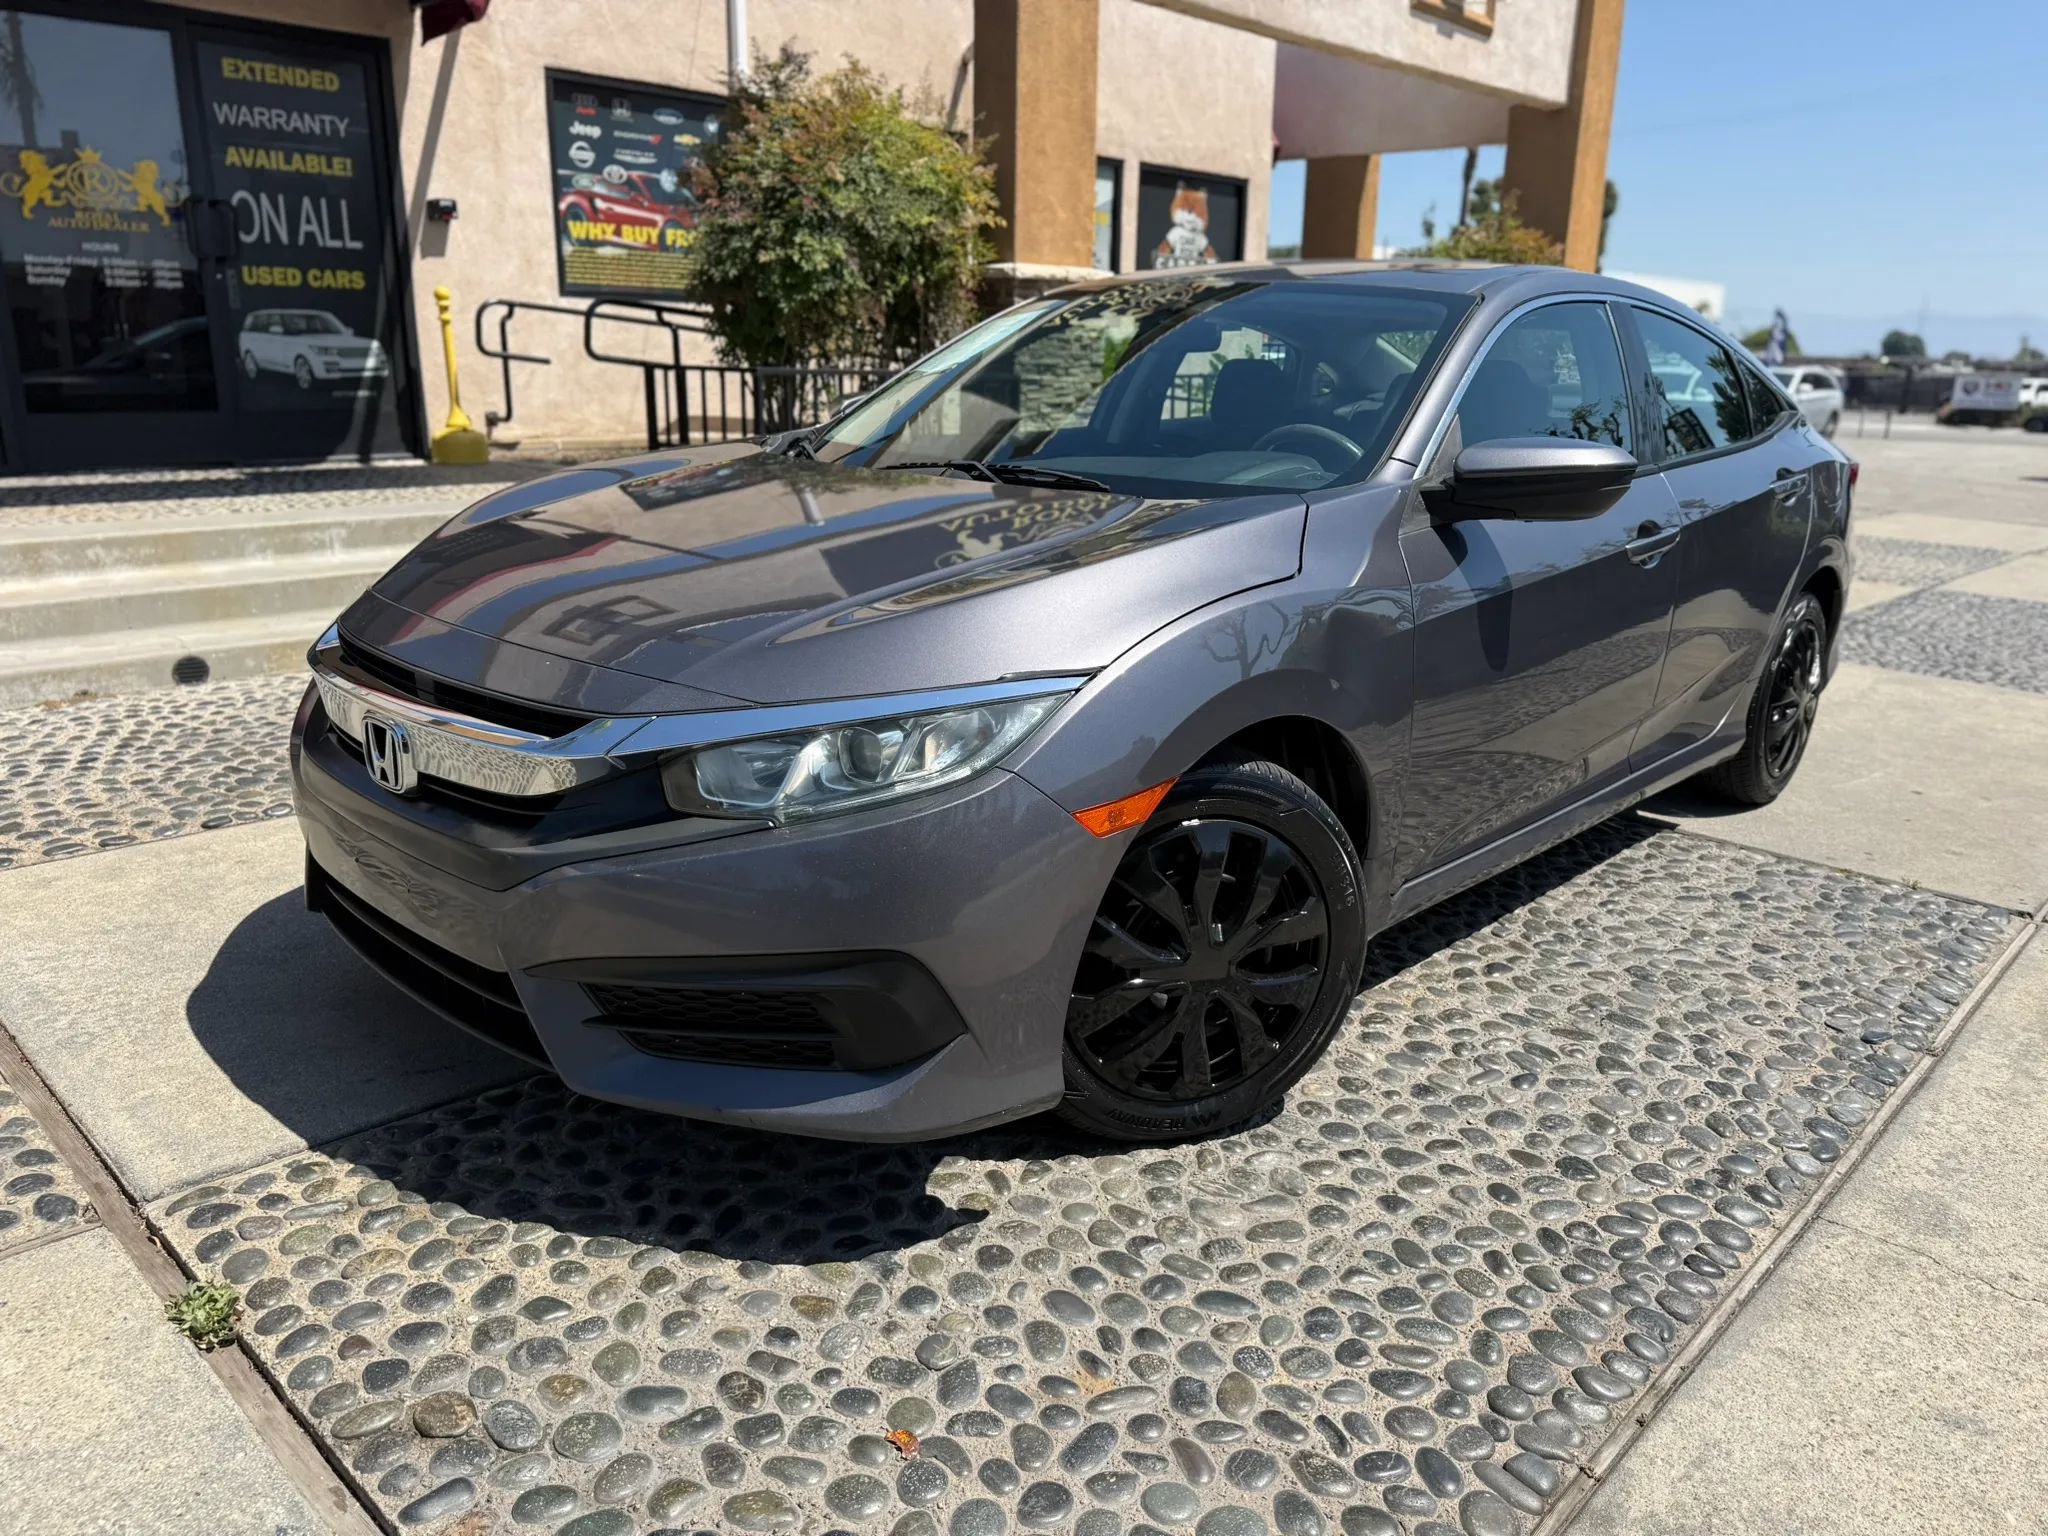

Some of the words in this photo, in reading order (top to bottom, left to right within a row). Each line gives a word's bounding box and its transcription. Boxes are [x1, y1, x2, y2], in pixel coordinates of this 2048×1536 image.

[221, 57, 340, 92] EXTENDED
[212, 101, 349, 138] WARRANTY
[569, 121, 602, 139] Jeep
[225, 145, 353, 177] AVAILABLE!
[231, 190, 289, 245] ON
[298, 195, 364, 250] ALL
[567, 220, 617, 240] WHY
[621, 224, 660, 245] BUY
[241, 265, 303, 287] USED
[307, 268, 366, 291] CARS
